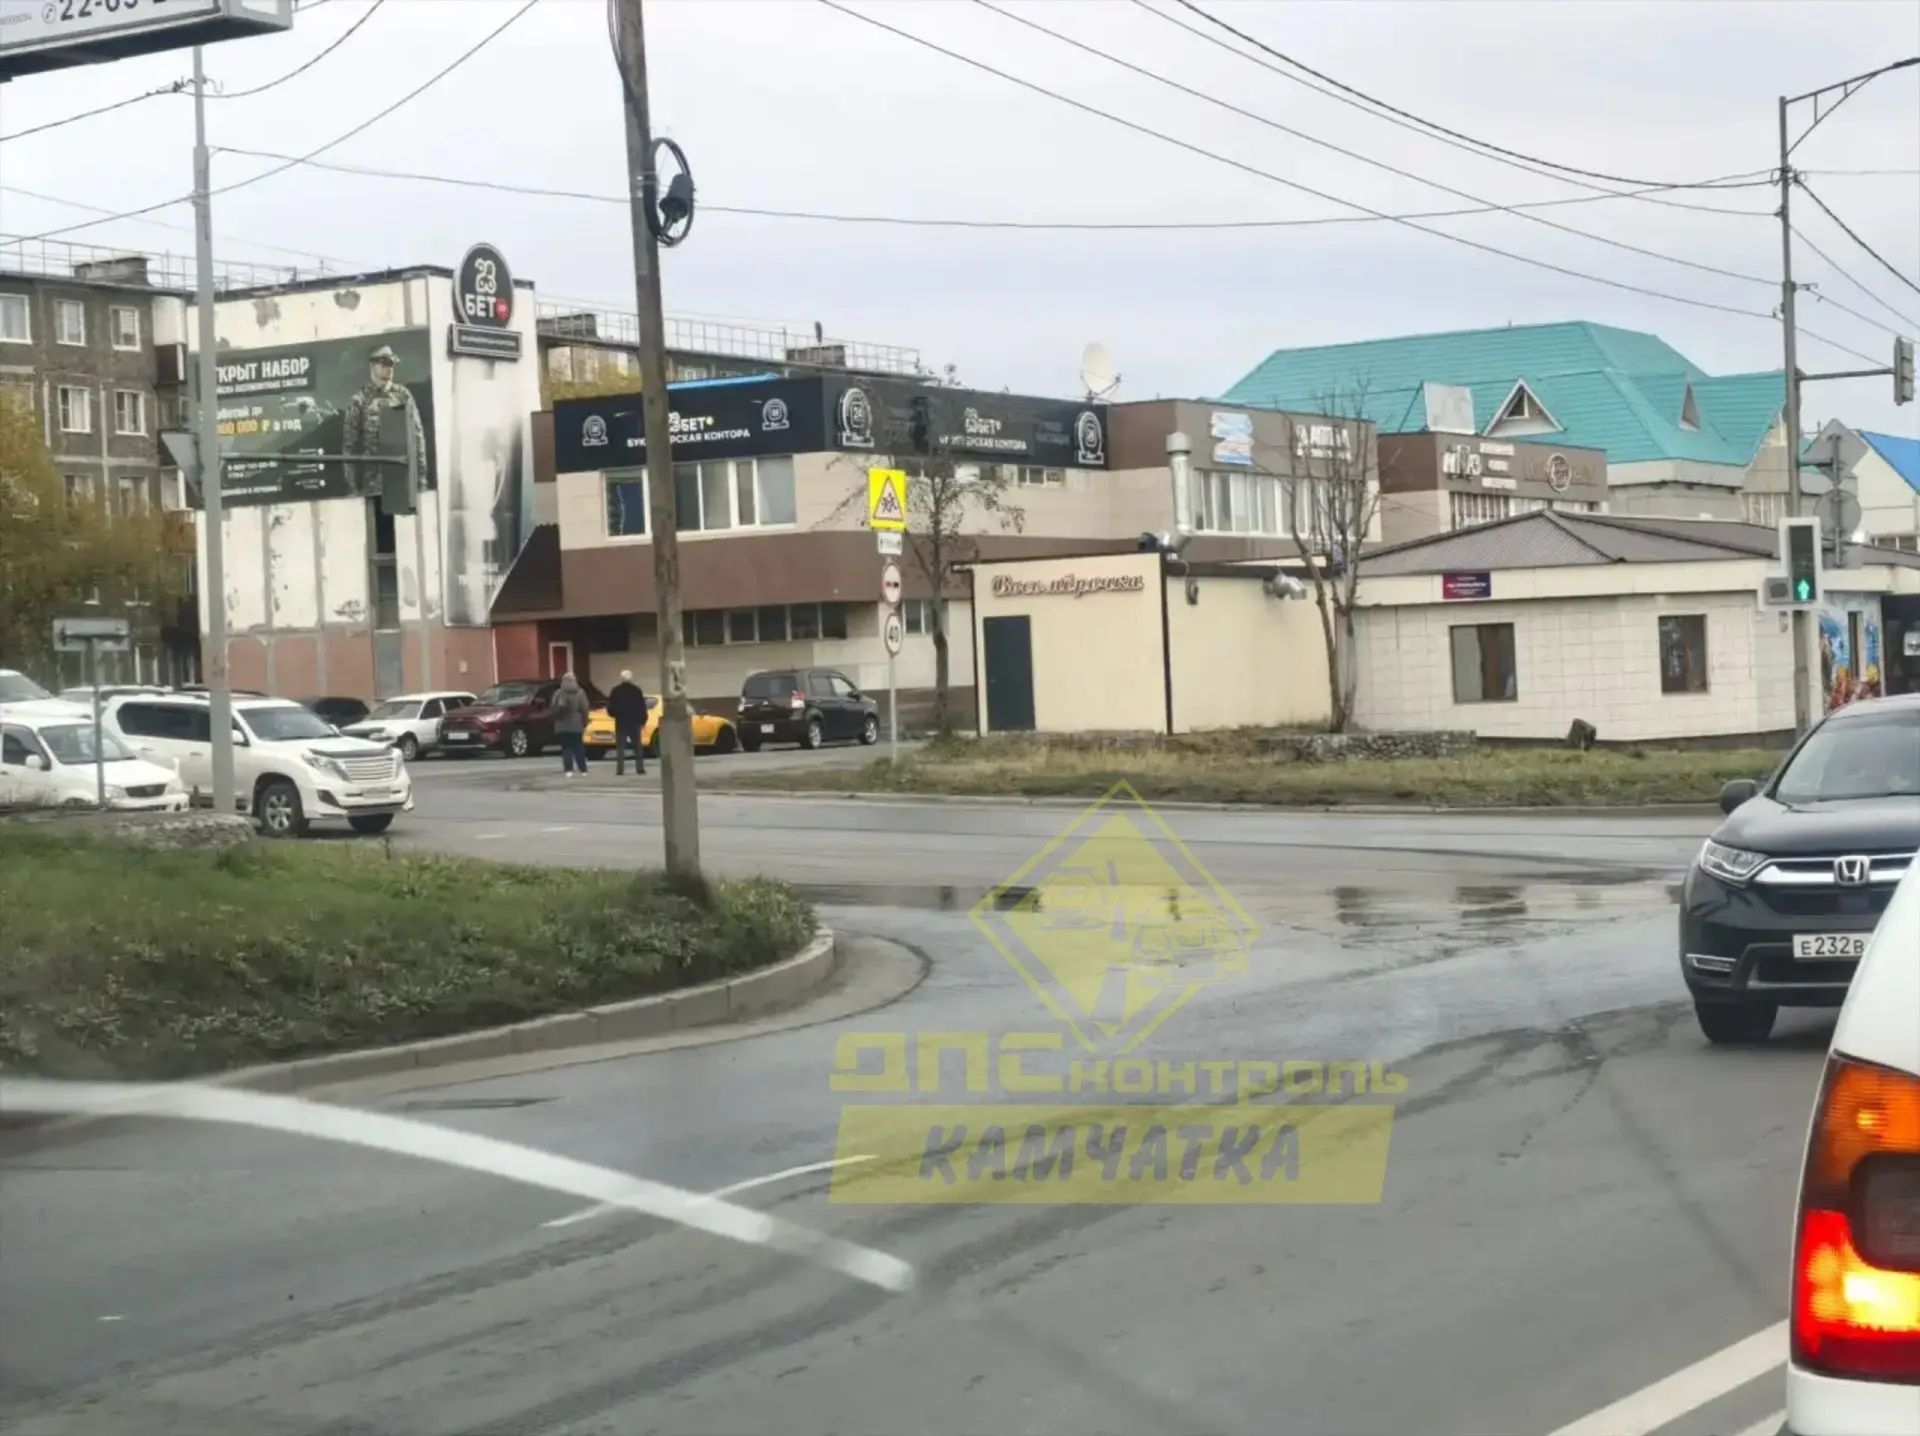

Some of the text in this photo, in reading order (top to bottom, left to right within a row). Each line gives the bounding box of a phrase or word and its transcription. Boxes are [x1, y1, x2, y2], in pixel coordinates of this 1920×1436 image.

[214, 357, 309, 383] КРЫТ НАБОР
[704, 428, 751, 442] КОНТОРА
[888, 626, 900, 643] 40
